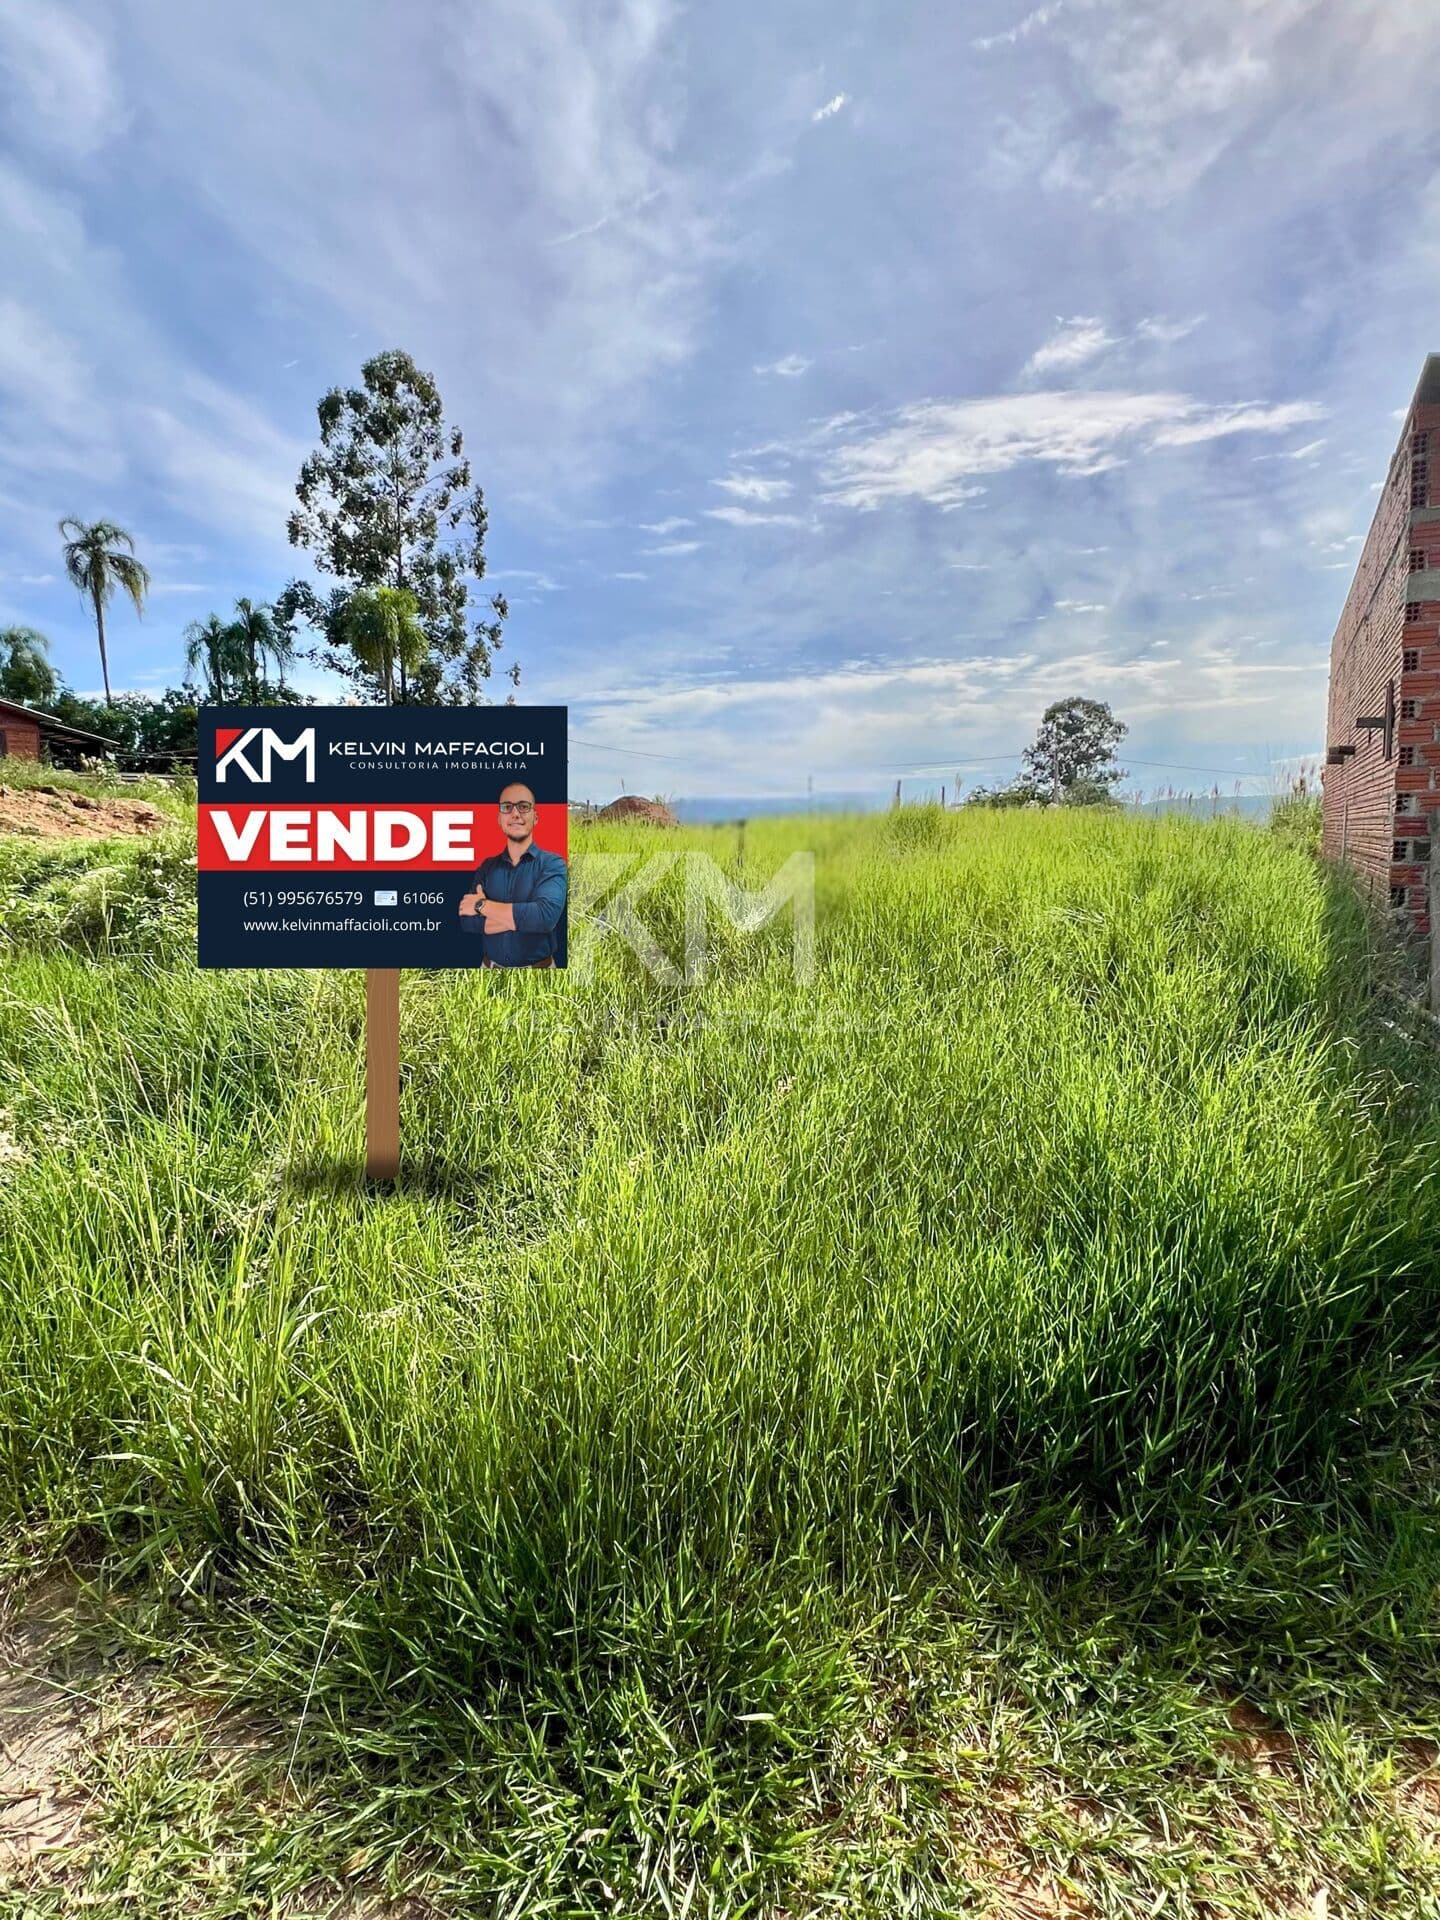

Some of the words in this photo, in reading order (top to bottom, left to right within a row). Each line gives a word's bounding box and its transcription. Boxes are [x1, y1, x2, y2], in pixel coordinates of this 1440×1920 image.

[215, 728, 315, 782] KM
[328, 741, 406, 756] KELVIN
[414, 741, 544, 756] MAFFACIOLI
[349, 760, 439, 770] CONSULTORIA
[445, 757, 527, 770] IMOBILIÁRIA
[209, 810, 475, 862] VENDE
[243, 890, 273, 908] (51)
[277, 891, 363, 906] 995676579
[403, 892, 444, 905] 61066
[243, 918, 442, 933] www.kelvinmaffacioli.com.br
